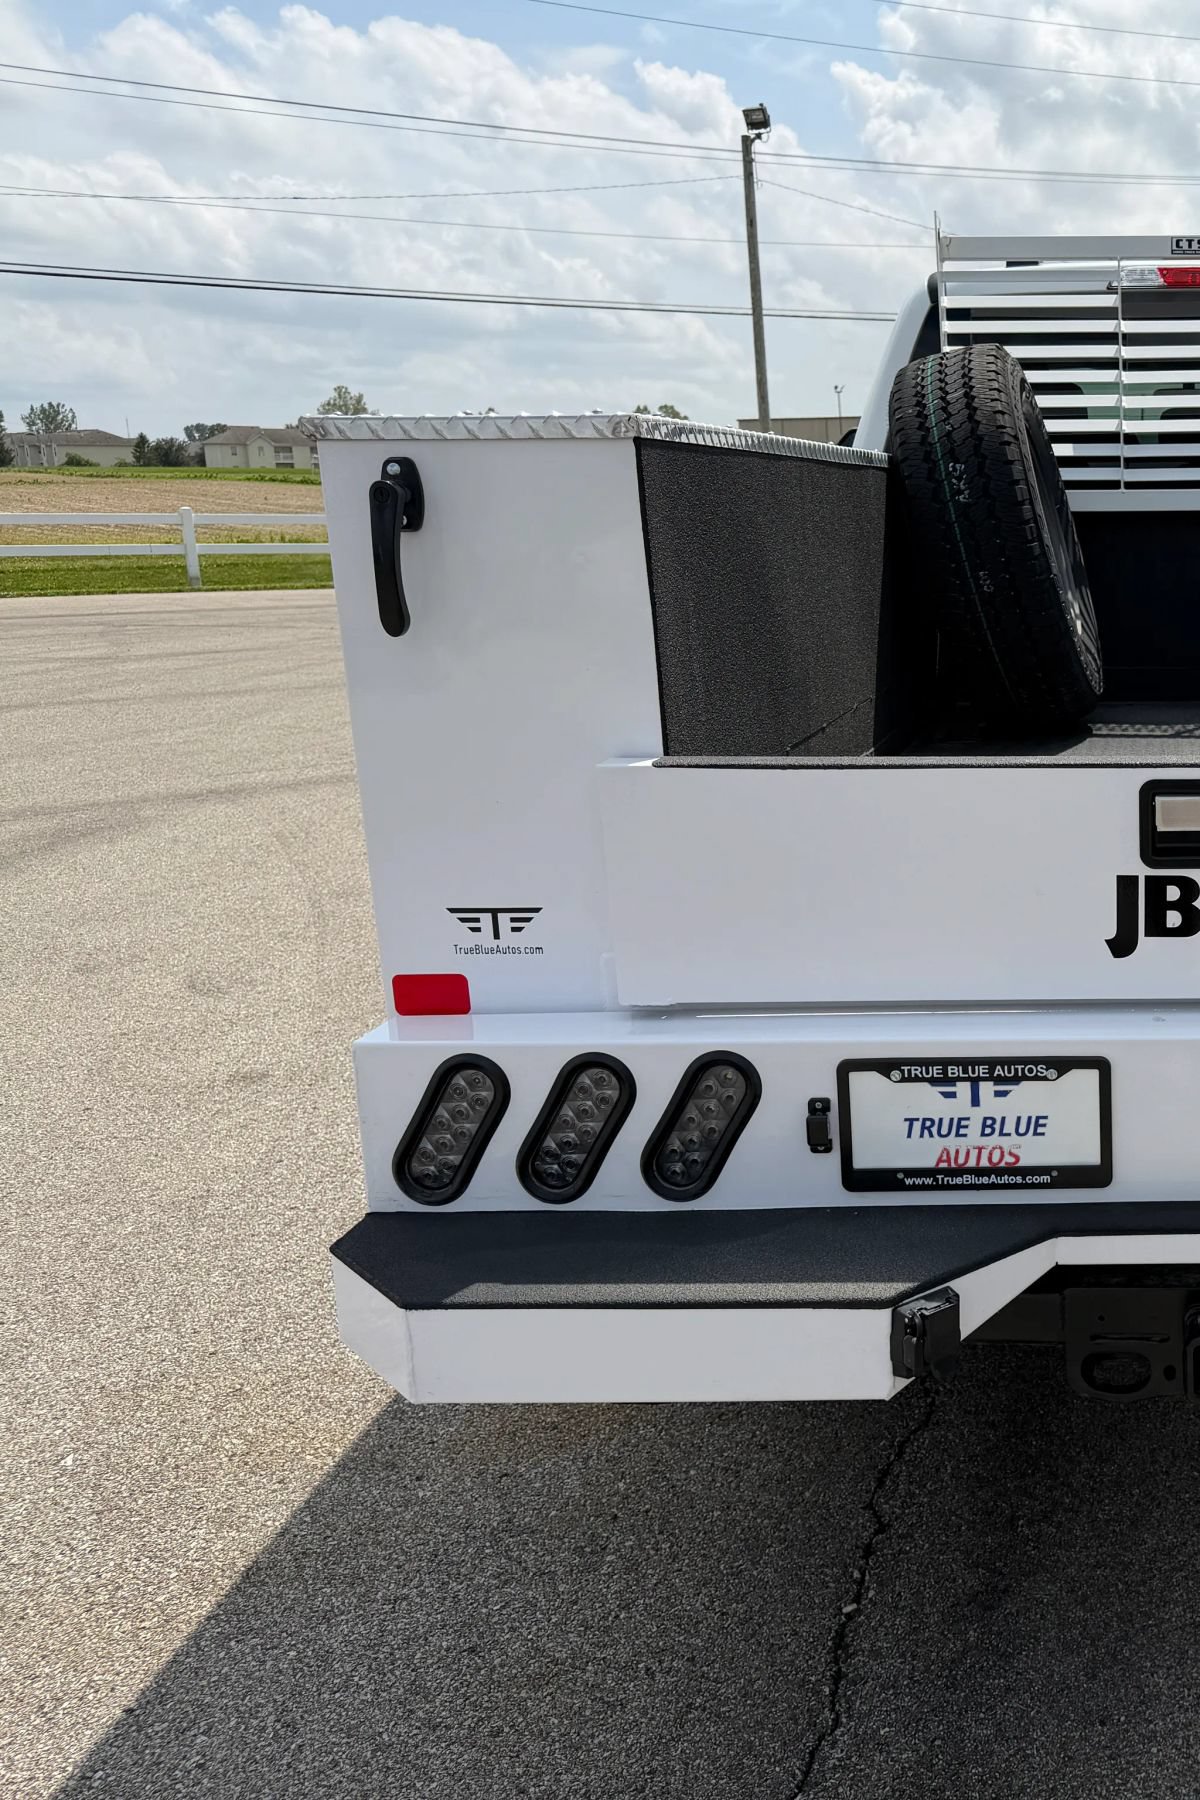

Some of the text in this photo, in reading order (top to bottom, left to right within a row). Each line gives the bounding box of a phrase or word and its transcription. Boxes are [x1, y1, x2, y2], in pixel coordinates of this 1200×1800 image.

[453, 944, 544, 956] TrueBlueAutos.com
[901, 1064, 1048, 1079] TRUE BLUE AUTOS
[903, 1114, 1049, 1139] TRUE BLUE
[934, 1143, 1023, 1168] AUTOS
[904, 1173, 1051, 1186] www.TrueBlueAutos.com
